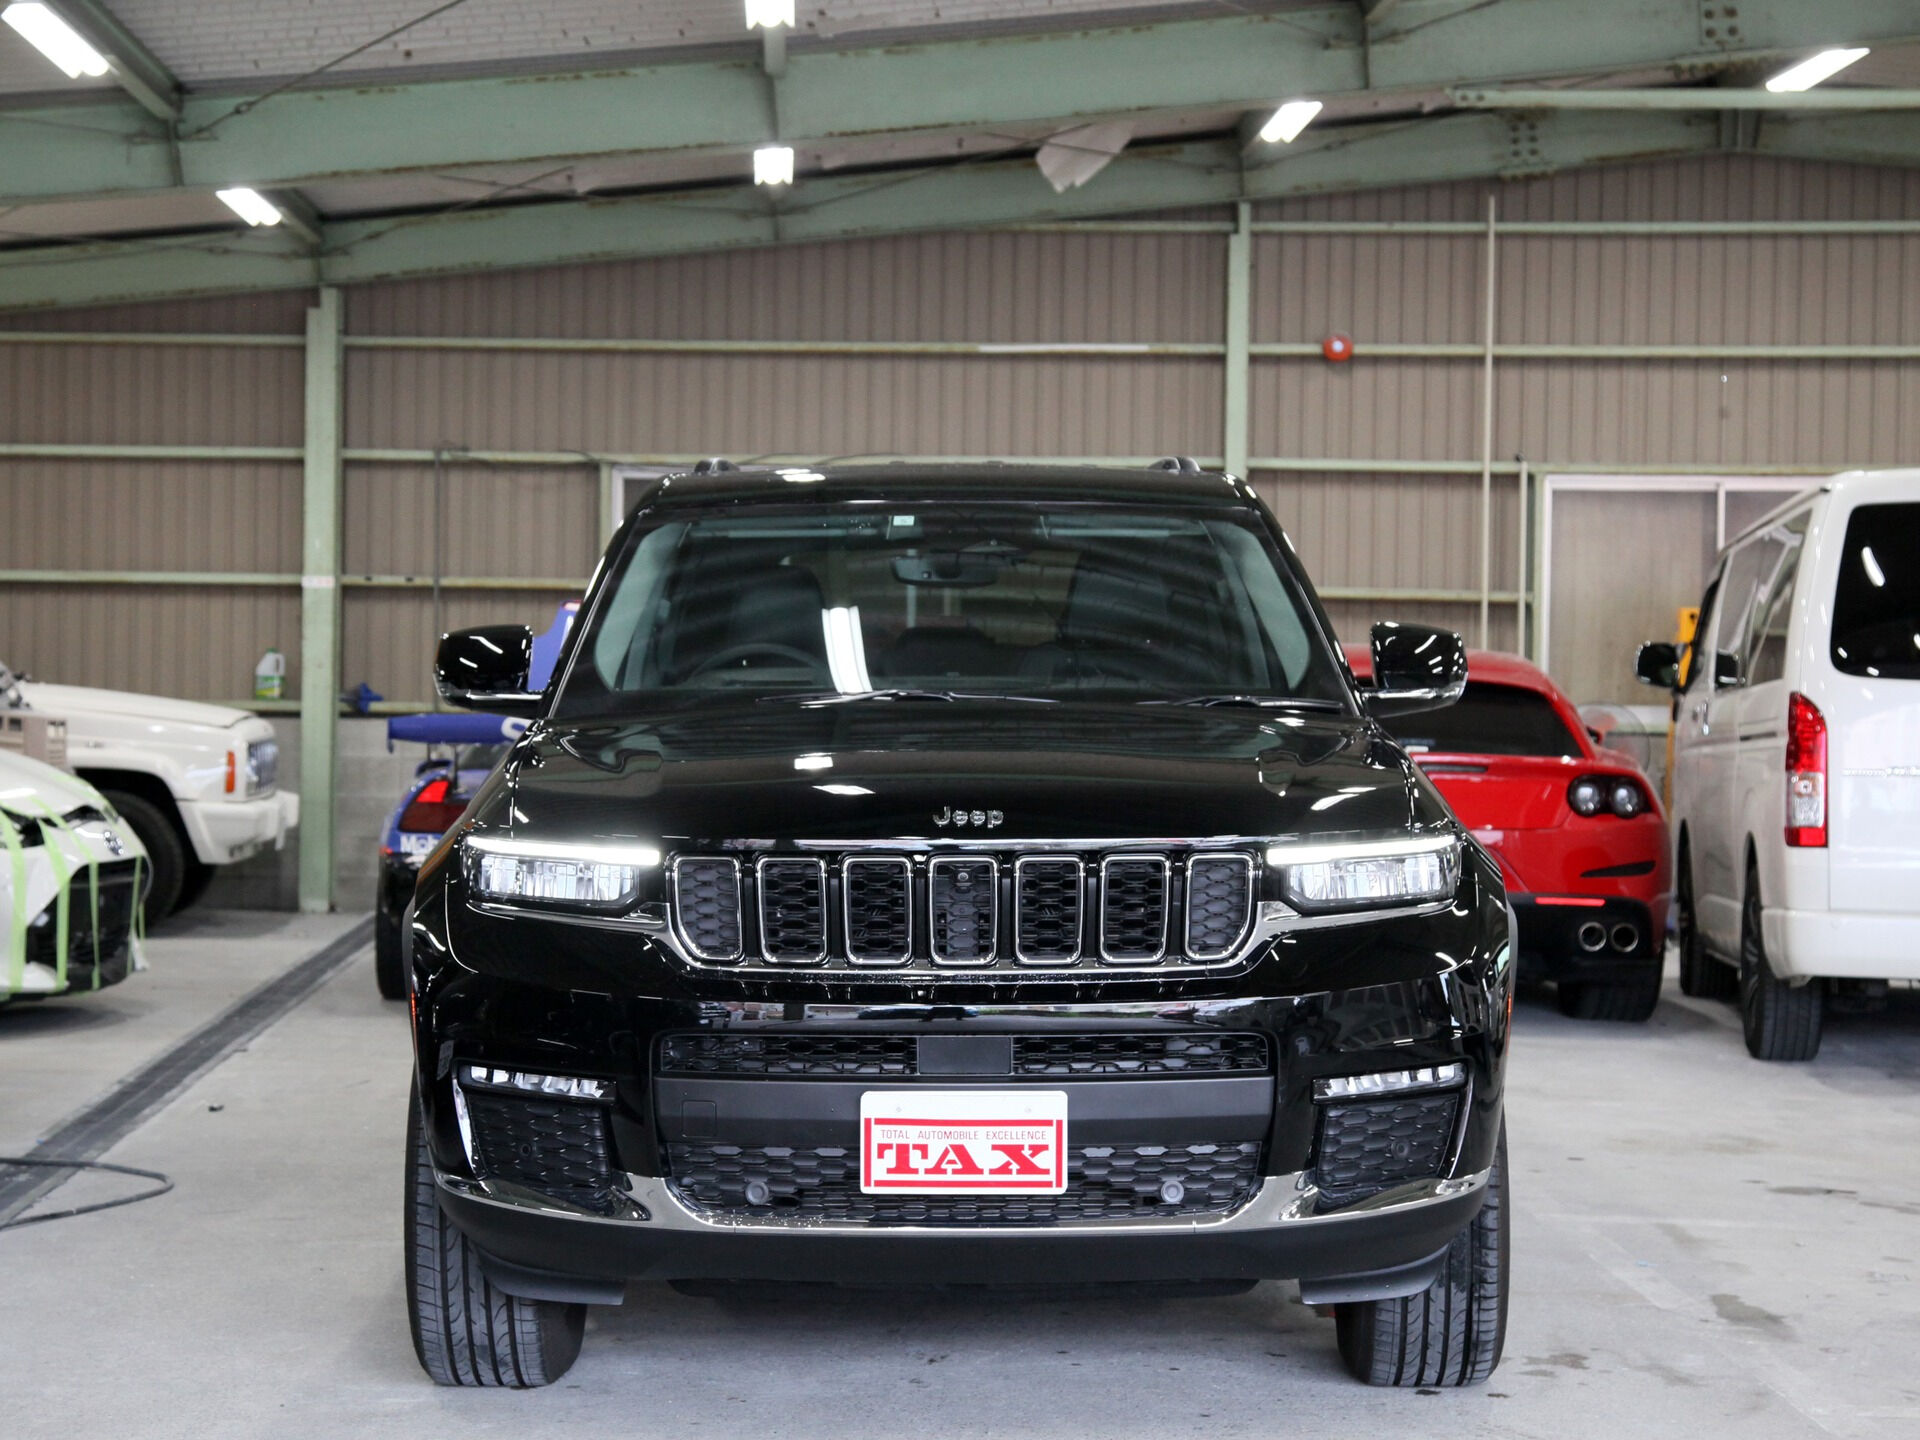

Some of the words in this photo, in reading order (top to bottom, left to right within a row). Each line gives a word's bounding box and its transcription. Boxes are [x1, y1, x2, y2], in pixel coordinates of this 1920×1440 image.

[932, 806, 1004, 828] Jeep
[881, 1129, 910, 1140] TOTAL
[917, 1130, 979, 1140] AUTOMOBILE
[986, 1130, 1046, 1140] EXCELLENCE
[877, 1143, 1050, 1175] TAX
